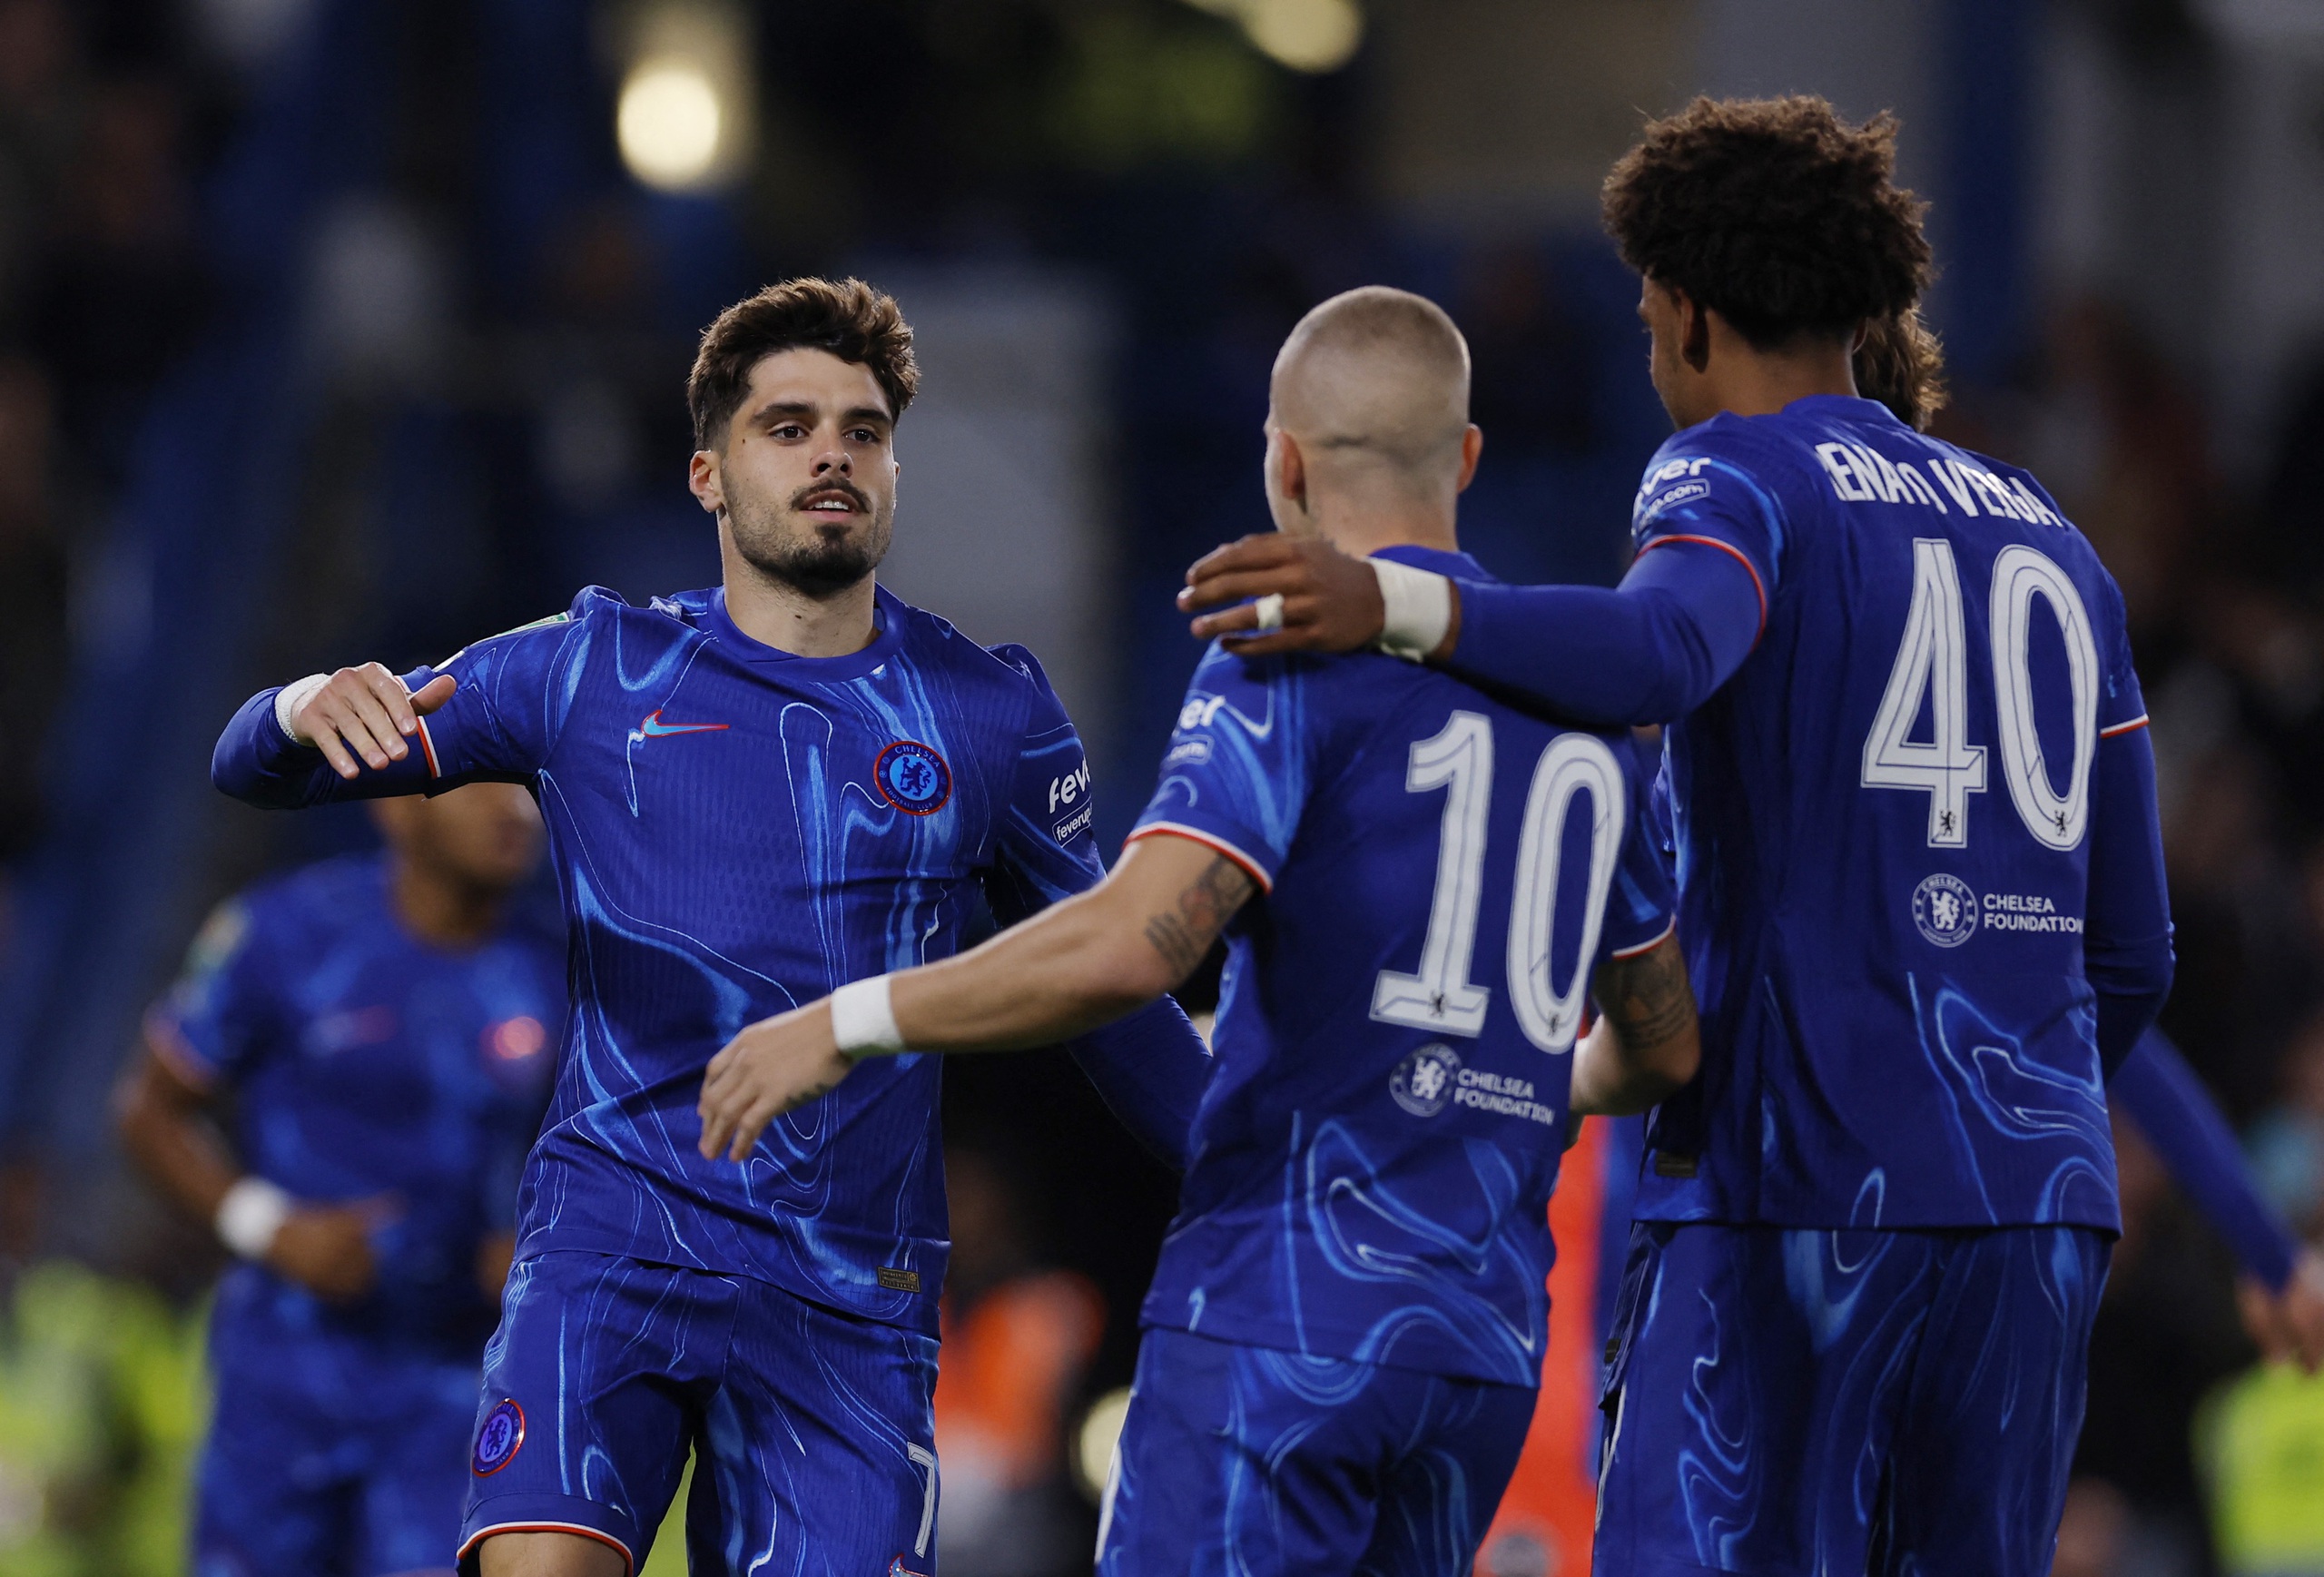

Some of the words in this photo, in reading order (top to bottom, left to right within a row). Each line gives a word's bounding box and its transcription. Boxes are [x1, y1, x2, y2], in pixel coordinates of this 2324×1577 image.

[1927, 458, 2063, 527] VEIGA
[1861, 537, 2099, 852] 40
[894, 744, 940, 767] CHELSEA
[1049, 759, 1091, 814] fev
[1369, 710, 1626, 1055] 10
[1983, 893, 2055, 913] CHELSEA
[1984, 912, 2084, 935] FOUNDATION
[1453, 1087, 1556, 1126] FOUNDATION
[1457, 1068, 1535, 1100] CHELSEA
[907, 1441, 936, 1559] 7
